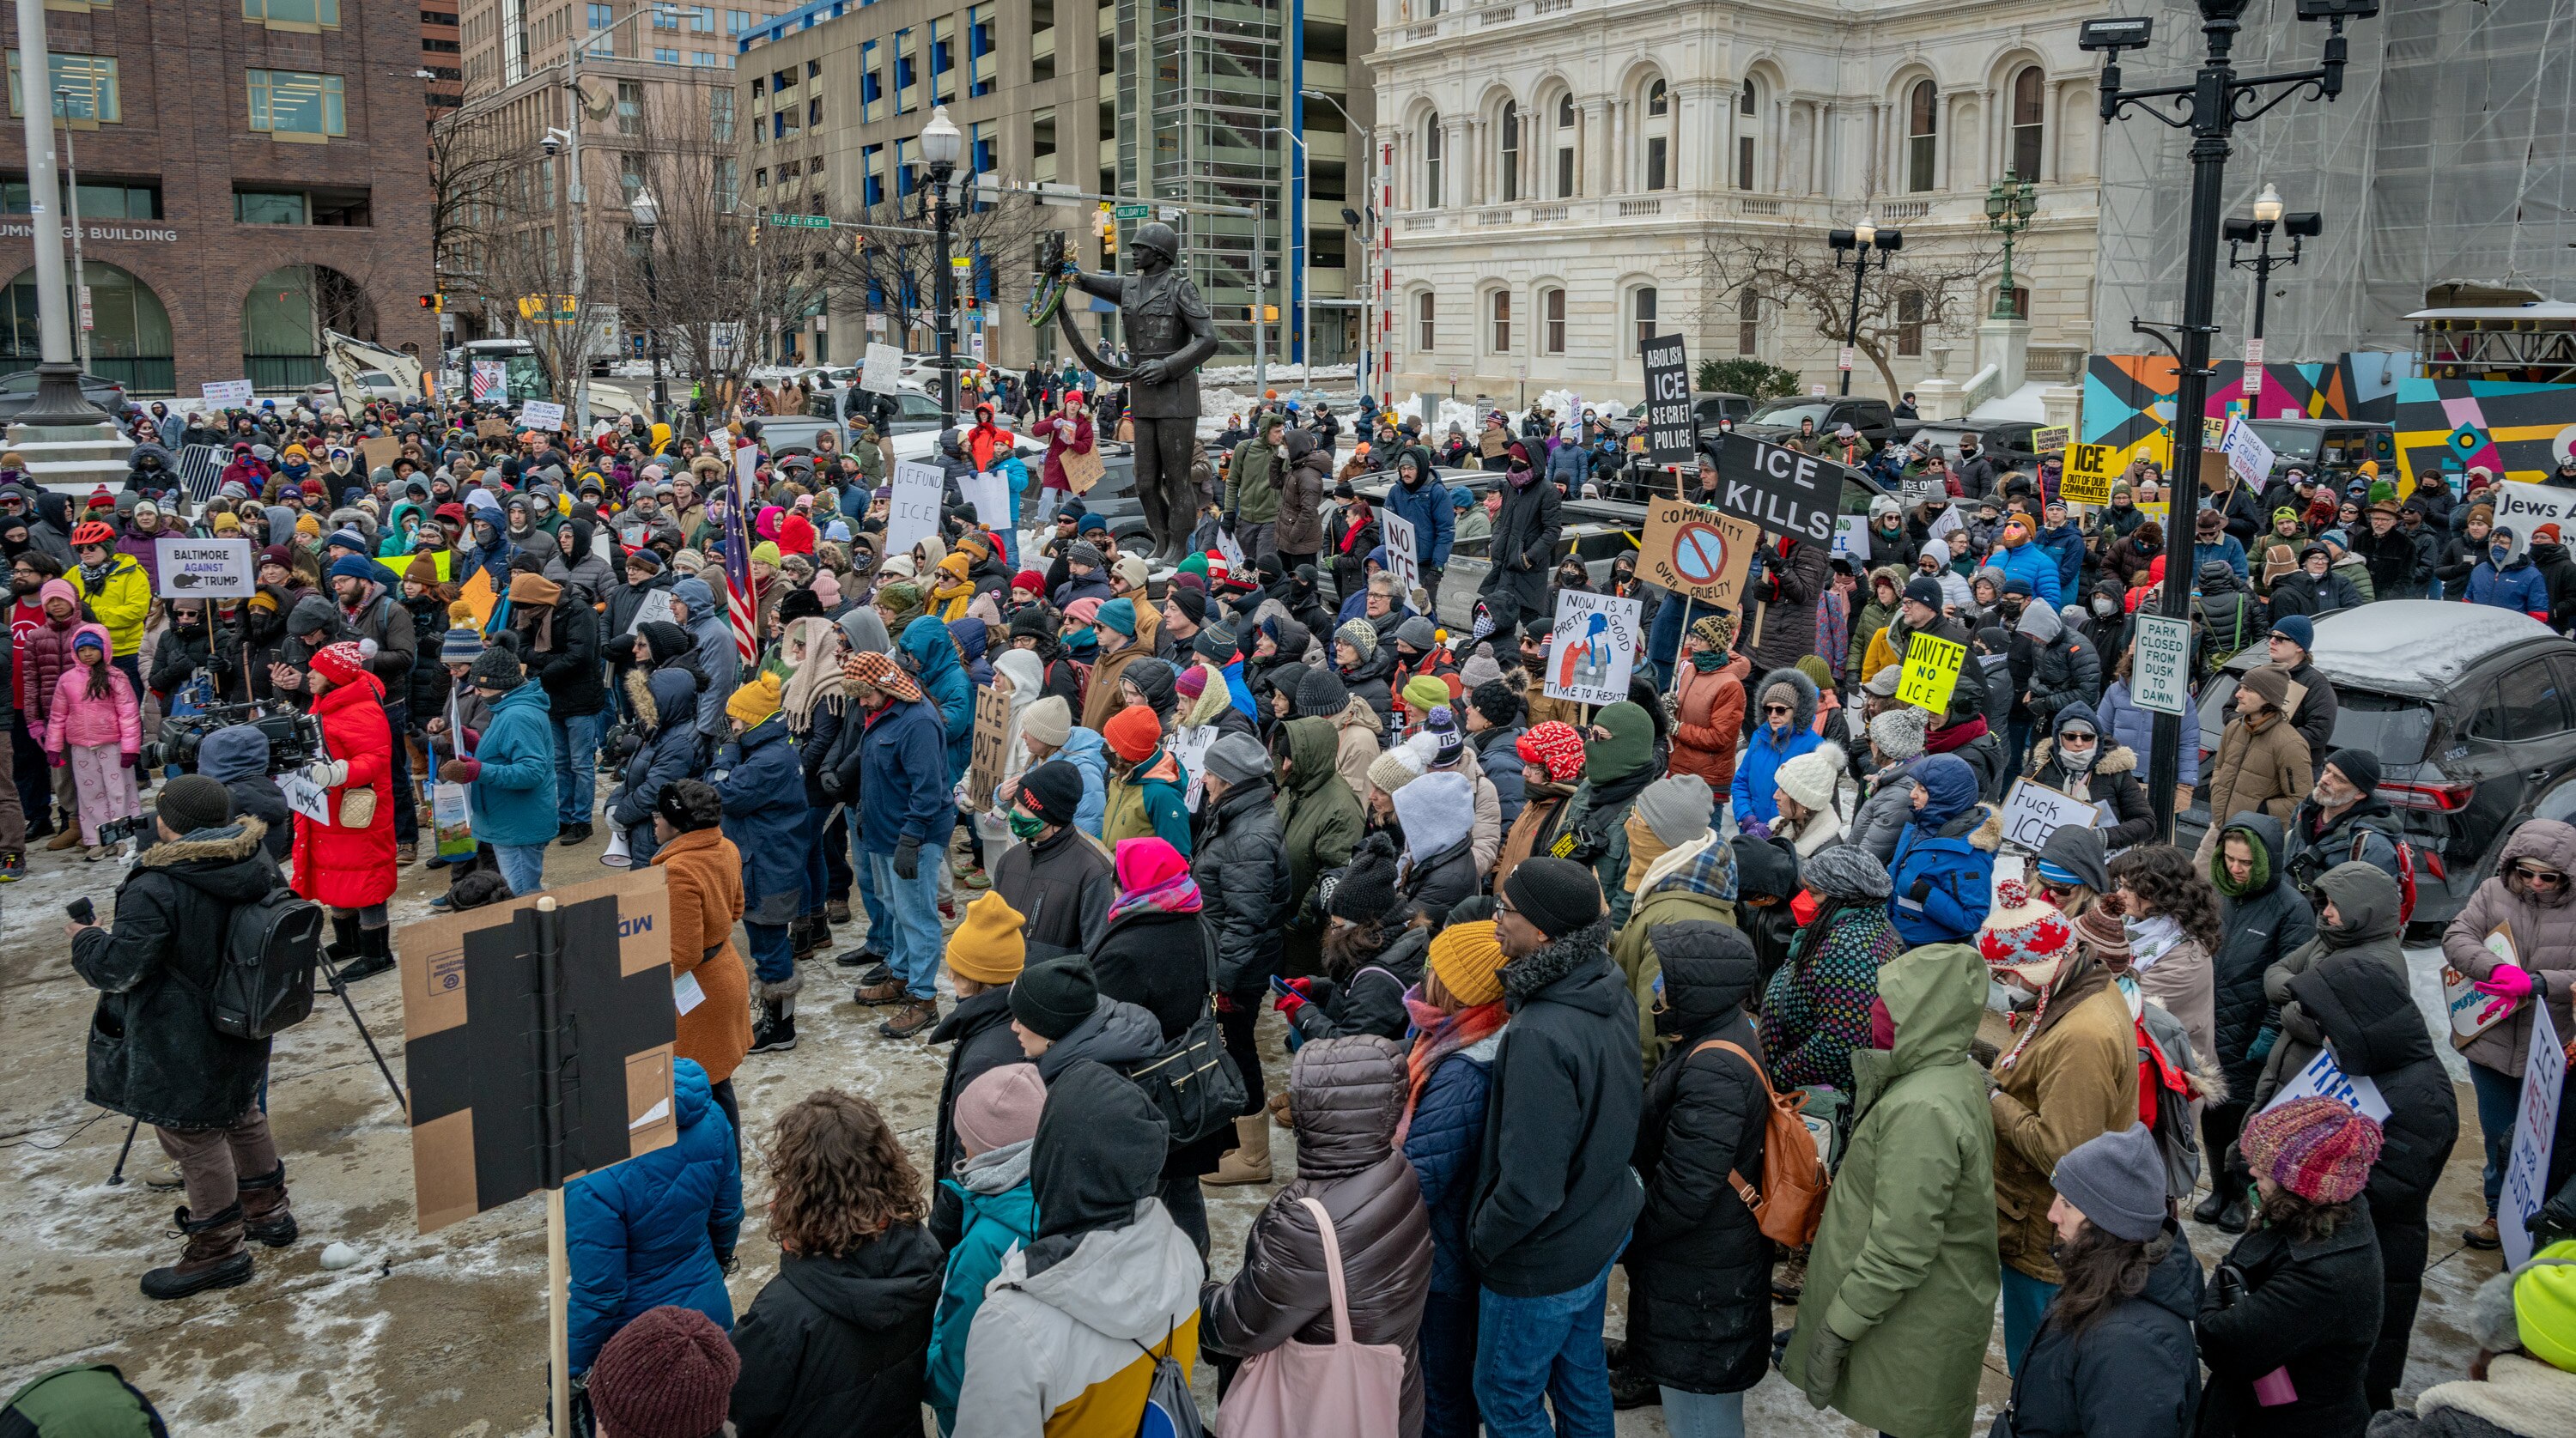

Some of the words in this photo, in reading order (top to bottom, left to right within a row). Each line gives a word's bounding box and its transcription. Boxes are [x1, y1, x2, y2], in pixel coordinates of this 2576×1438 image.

[1118, 209, 1139, 217] HOLLIDAY
[90, 228, 177, 243] BUILDING
[874, 346, 896, 364] NO
[1647, 345, 1684, 369] ABOLISH
[392, 364, 413, 390] TEREX
[1654, 371, 1686, 402] ICE
[1652, 403, 1690, 426] SECRET
[1654, 429, 1691, 450] POLICE
[2037, 428, 2053, 437] FIND
[2053, 427, 2069, 435] YOUR
[2037, 434, 2069, 445] HUMANITY
[2242, 431, 2263, 456] ILLEGAL
[1754, 443, 1819, 489] ICE
[2074, 445, 2106, 474] ICE
[2238, 444, 2258, 469] CRUEL
[897, 465, 943, 490] DEFUND
[1902, 479, 1917, 490] ICE
[2067, 474, 2082, 484] OUT
[2081, 475, 2092, 485] OF
[2091, 476, 2106, 488] OUR
[2233, 455, 2267, 492] ENRAGING!
[2062, 482, 2110, 497] COMMUNITIES
[900, 503, 933, 523] ICE
[1724, 479, 1831, 541] KILLS
[2500, 494, 2557, 518] Jews
[1662, 507, 1744, 541] COMMUNITY
[1388, 521, 1410, 553] NO
[173, 549, 229, 561] BALTIMORE
[184, 562, 224, 573] AGAINST
[1388, 549, 1415, 595] ICE
[204, 576, 239, 586] TRUMP
[1656, 561, 1679, 591] OVER
[1690, 579, 1731, 599] CRUELTY
[1567, 594, 1596, 610] NOW
[1605, 600, 1618, 613] IS
[1624, 603, 1634, 616] A
[1554, 610, 1588, 640] PRETTI
[1609, 615, 1631, 652] GOOD
[2148, 624, 2178, 639] PARK
[1907, 635, 1965, 672] UNITE
[2141, 636, 2184, 652] CLOSED
[2145, 651, 2177, 665] FROM
[1916, 665, 1936, 681] NO
[2145, 664, 2174, 678] DUSK
[1546, 682, 1578, 699] TIME
[1582, 688, 1592, 699] TO
[1597, 689, 1627, 702] RESIST
[1906, 682, 1935, 705] ICE
[2152, 678, 2166, 690] TO
[2142, 689, 2174, 705] DAWN
[976, 690, 1005, 730] ICE
[1187, 726, 1212, 749] WARY
[974, 731, 1002, 773] OUT
[2014, 781, 2061, 821] Fuck
[2011, 814, 2057, 850] ICE
[433, 965, 465, 979] orrugated
[2534, 1028, 2556, 1101] ICE
[2524, 1070, 2550, 1155] MELTS
[2509, 1150, 2537, 1241] JUSTIC
